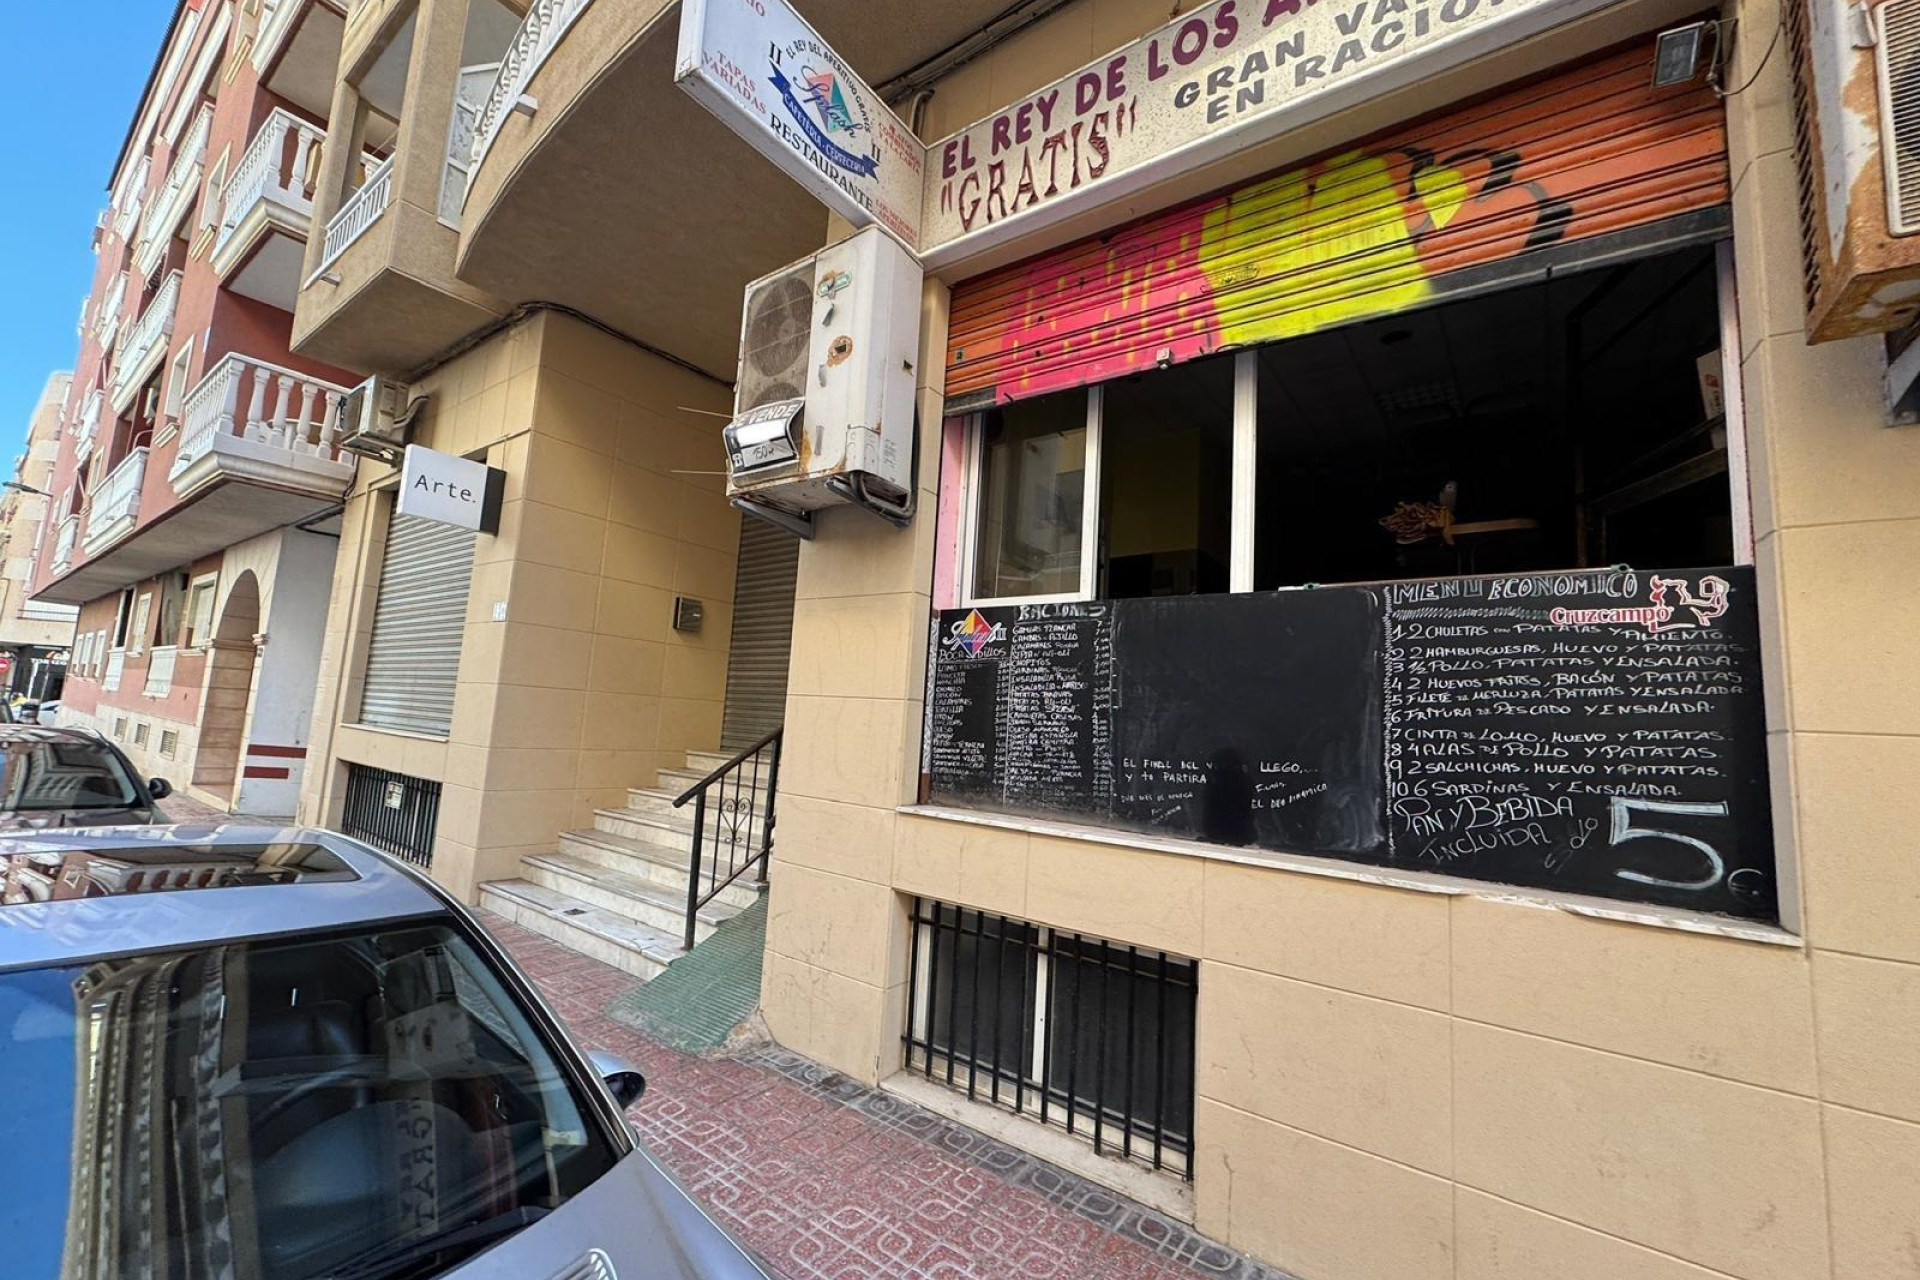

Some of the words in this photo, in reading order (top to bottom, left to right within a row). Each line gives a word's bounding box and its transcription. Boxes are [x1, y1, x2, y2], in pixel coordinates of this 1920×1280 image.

[785, 47, 795, 60] EL
[794, 38, 807, 52] REY
[808, 40, 823, 58] DEL
[716, 50, 757, 93] TAPAS
[1173, 30, 1305, 109] GRAN
[701, 50, 768, 115] VARIADAS
[941, 134, 976, 179] EL
[991, 88, 1059, 156] REY
[1075, 55, 1127, 116] DE
[1147, 0, 1239, 82] LOS
[1206, 78, 1265, 124] EN
[770, 112, 873, 213] RESTAURANTE
[748, 404, 799, 425] VENDE
[414, 474, 476, 504] Arte.
[1392, 579, 1483, 605] MENU
[1487, 572, 1638, 601] ECONOMICO
[1549, 606, 1673, 632] Cruzcampo
[1407, 623, 1425, 639] 2
[1424, 625, 1489, 639] CHULETAS
[1512, 623, 1602, 635] PATATAS
[1409, 647, 1428, 660] 2
[1552, 642, 1619, 653] HUEVO
[1391, 662, 1405, 674] 3
[1492, 657, 1595, 670] PATATAS
[1391, 677, 1402, 692] 4
[1407, 677, 1422, 690] 2
[1427, 677, 1483, 690] HUEVOS
[1638, 671, 1743, 684] PATATAS
[1391, 693, 1404, 708] 5
[1405, 690, 1453, 706] FILETE
[1548, 686, 1625, 700] PATATAS
[1391, 709, 1402, 724] 6
[1403, 707, 1473, 722] FRITURA
[1493, 701, 1573, 716] PESCADO
[1391, 728, 1402, 740] 7
[1404, 728, 1458, 741] CINTA
[1552, 731, 1607, 743] HUEVO
[1391, 743, 1402, 757] 8
[1407, 743, 1419, 757] 4
[1423, 743, 1475, 757] ALAS
[1501, 741, 1570, 757] POLLO
[1123, 757, 1136, 768] EL
[1143, 758, 1172, 769] FINAL
[1389, 759, 1402, 780] 9
[1407, 760, 1422, 775] 2
[1533, 763, 1596, 775] HUEVO
[1163, 771, 1207, 784] PARTIRA
[1391, 780, 1409, 798] 10
[1413, 778, 1429, 797] 6
[1431, 779, 1531, 797] SARDINAS
[1393, 797, 1445, 837] PAN
[1457, 792, 1574, 831] BEBIDA
